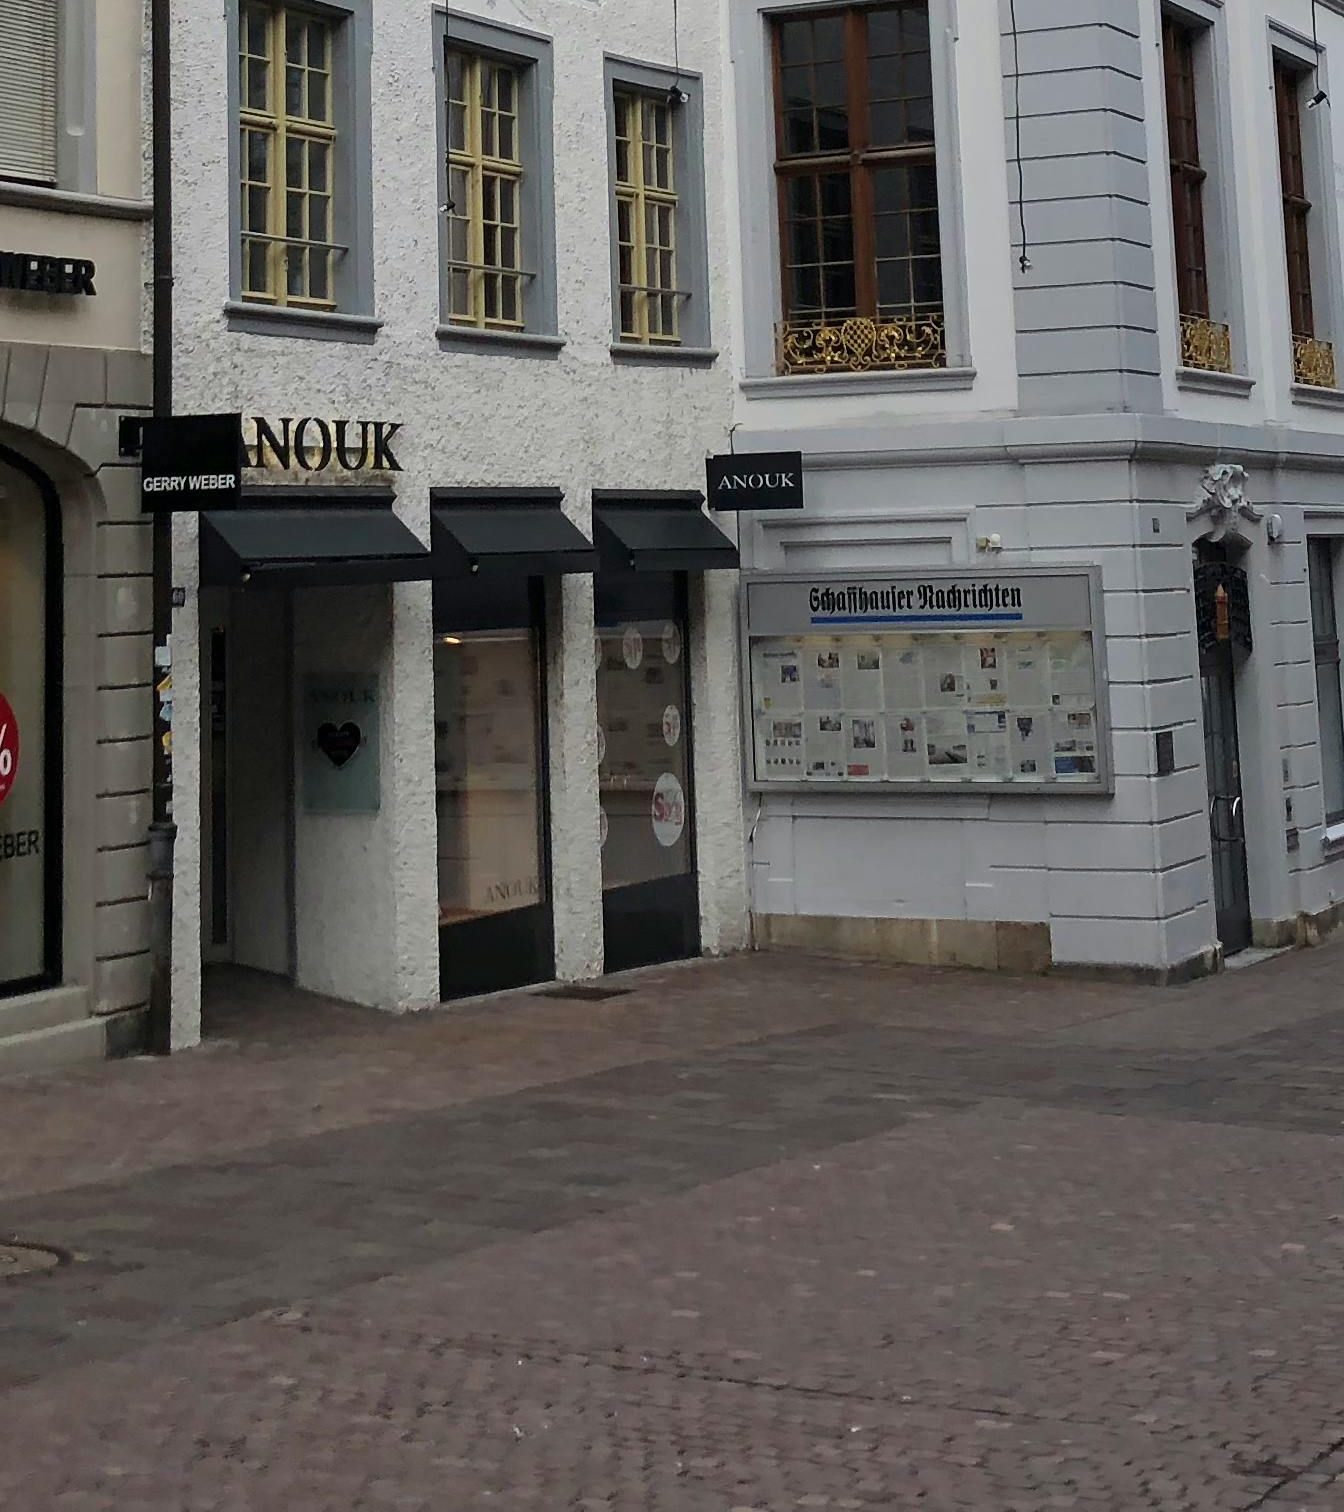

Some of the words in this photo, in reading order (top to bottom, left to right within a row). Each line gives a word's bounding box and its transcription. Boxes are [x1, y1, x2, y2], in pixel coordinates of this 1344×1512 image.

[143, 475, 188, 493] GERRY
[188, 473, 236, 491] WEBER
[717, 472, 795, 491] ANOUK
[916, 583, 1023, 612] Nachrichten
